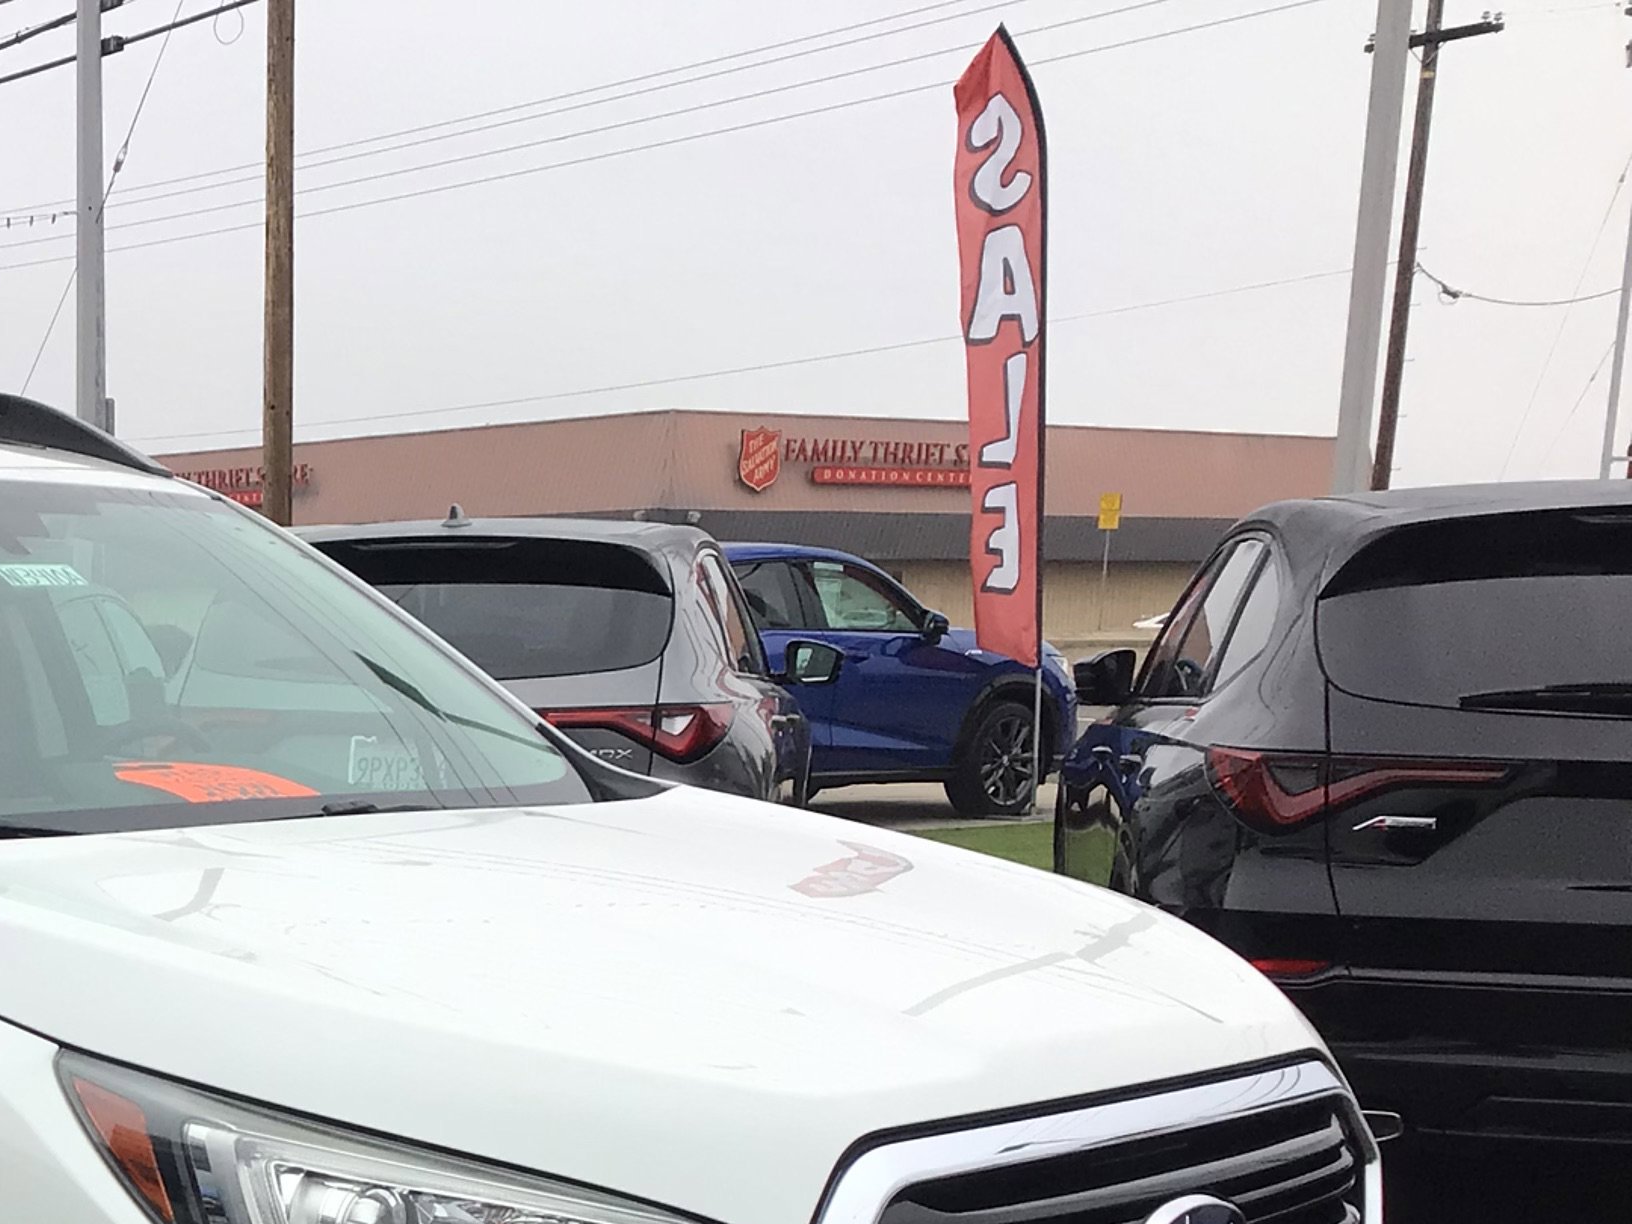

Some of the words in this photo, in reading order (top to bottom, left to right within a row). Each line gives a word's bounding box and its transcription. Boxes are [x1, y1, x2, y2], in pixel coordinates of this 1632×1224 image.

[784, 438, 865, 464] FAMILY
[869, 441, 951, 466] THRIFT
[823, 469, 910, 483] DONATION
[917, 470, 972, 484] CENTE
